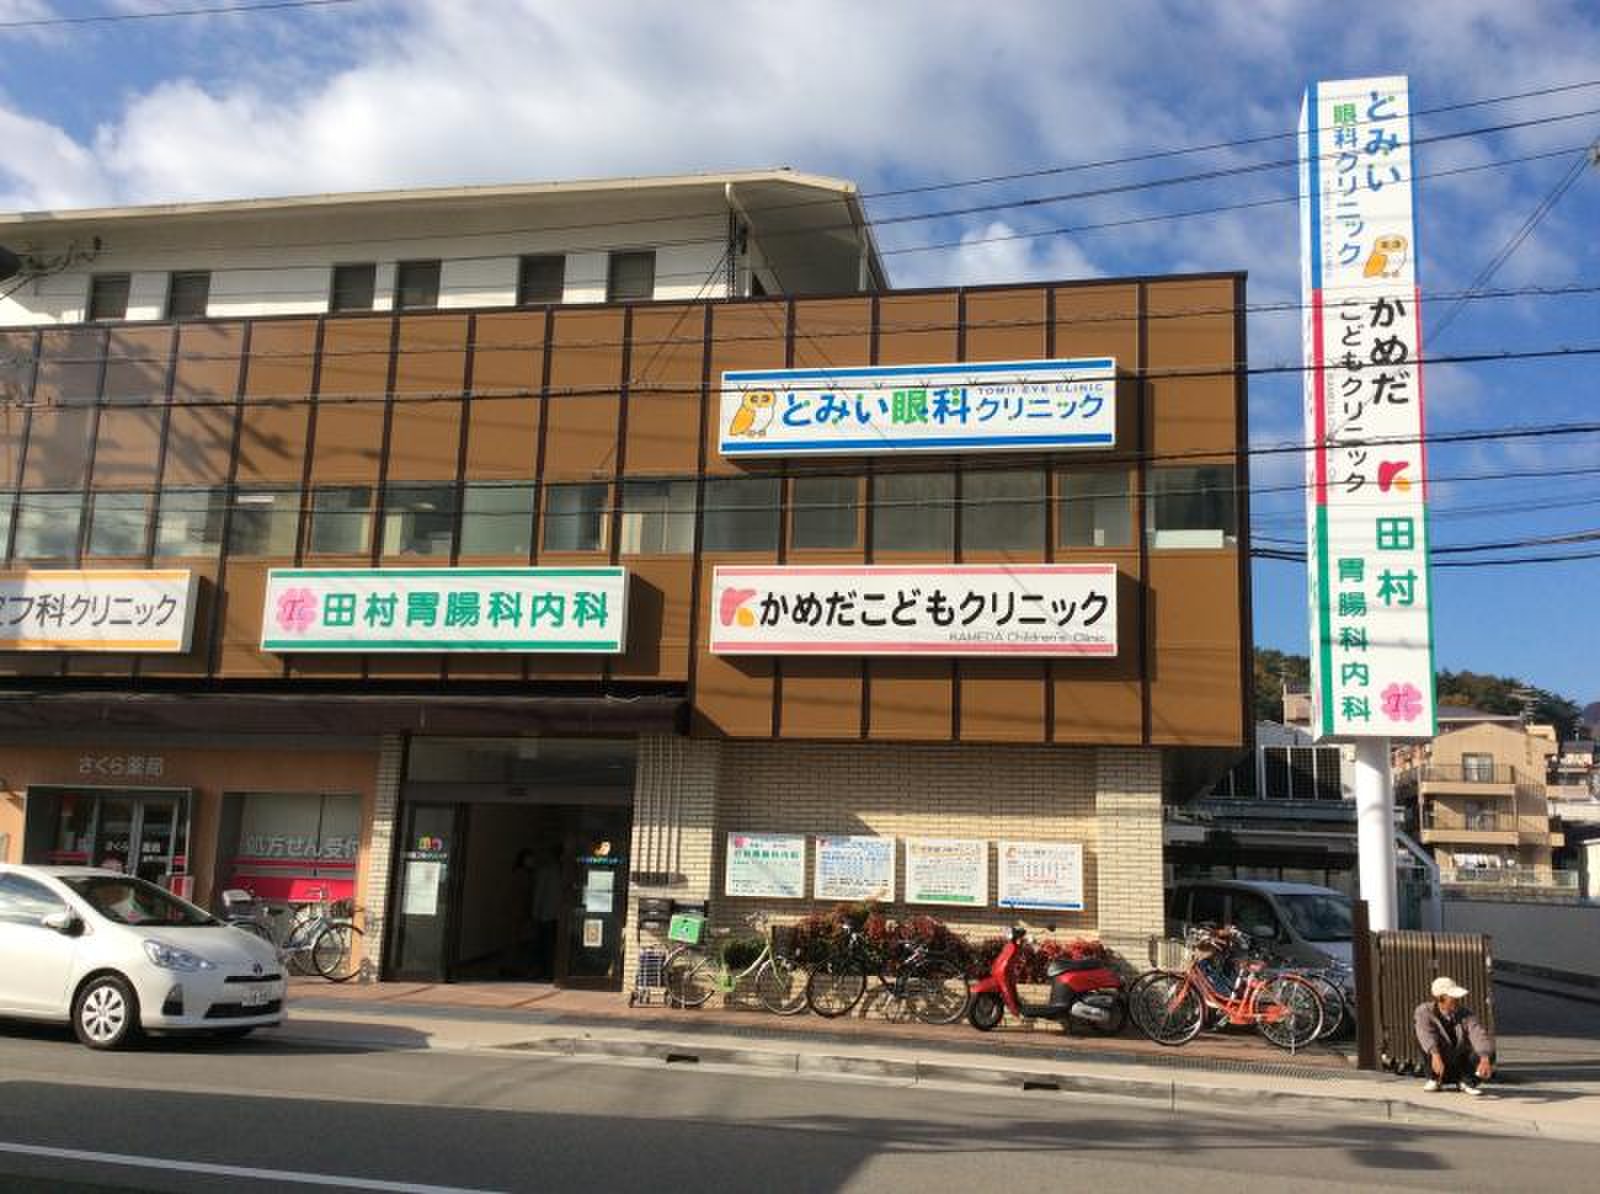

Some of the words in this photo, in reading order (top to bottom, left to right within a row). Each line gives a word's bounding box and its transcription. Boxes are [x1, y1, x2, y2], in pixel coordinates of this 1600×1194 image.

[1333, 103, 1364, 264] 眼科クリニック
[1365, 91, 1401, 191] とみい
[1340, 297, 1367, 493] こどもクリニック
[1369, 297, 1411, 404] かめだ
[782, 388, 1105, 426] とみい眼科クリニック
[1375, 516, 1418, 606] 田村
[0, 593, 177, 628] フ科クリニック
[322, 591, 609, 629] 田村胃腸科内科
[759, 589, 1109, 627] かめだこどもクリニック
[949, 632, 1004, 642] KAMEDA
[1337, 558, 1371, 722] 胃腸科内科
